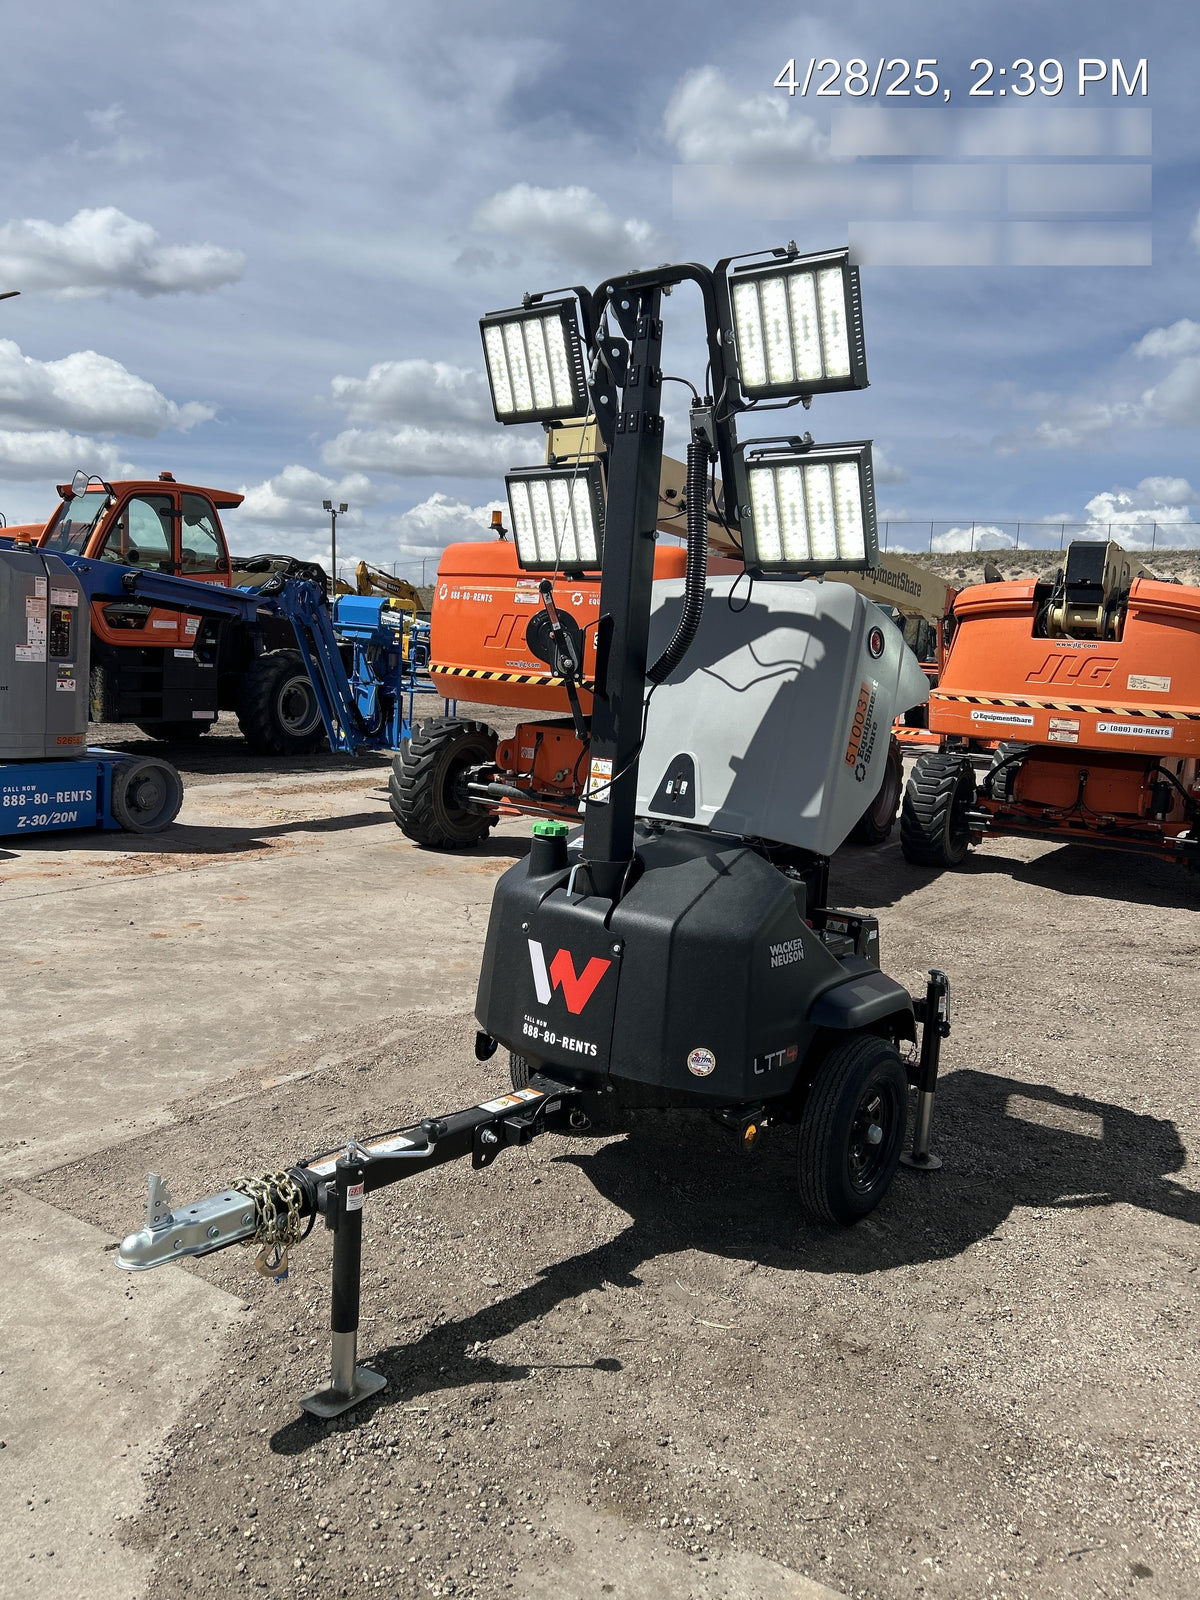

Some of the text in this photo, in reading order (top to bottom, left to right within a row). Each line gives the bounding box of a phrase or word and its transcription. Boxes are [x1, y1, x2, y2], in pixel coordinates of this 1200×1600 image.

[854, 565, 922, 597] quipmentShare
[1055, 641, 1098, 649] www.jlg.com
[845, 687, 871, 766] 510031
[979, 712, 1032, 724] EquipmentShare
[863, 721, 878, 765] Share
[3, 790, 92, 807] 888-80-RENTS
[17, 811, 78, 828] Z-30/20N
[769, 938, 804, 957] WACKER
[770, 949, 805, 968] NEUSON
[524, 1014, 548, 1028] CALL NOW
[522, 1023, 598, 1057] 888-80-RENTS
